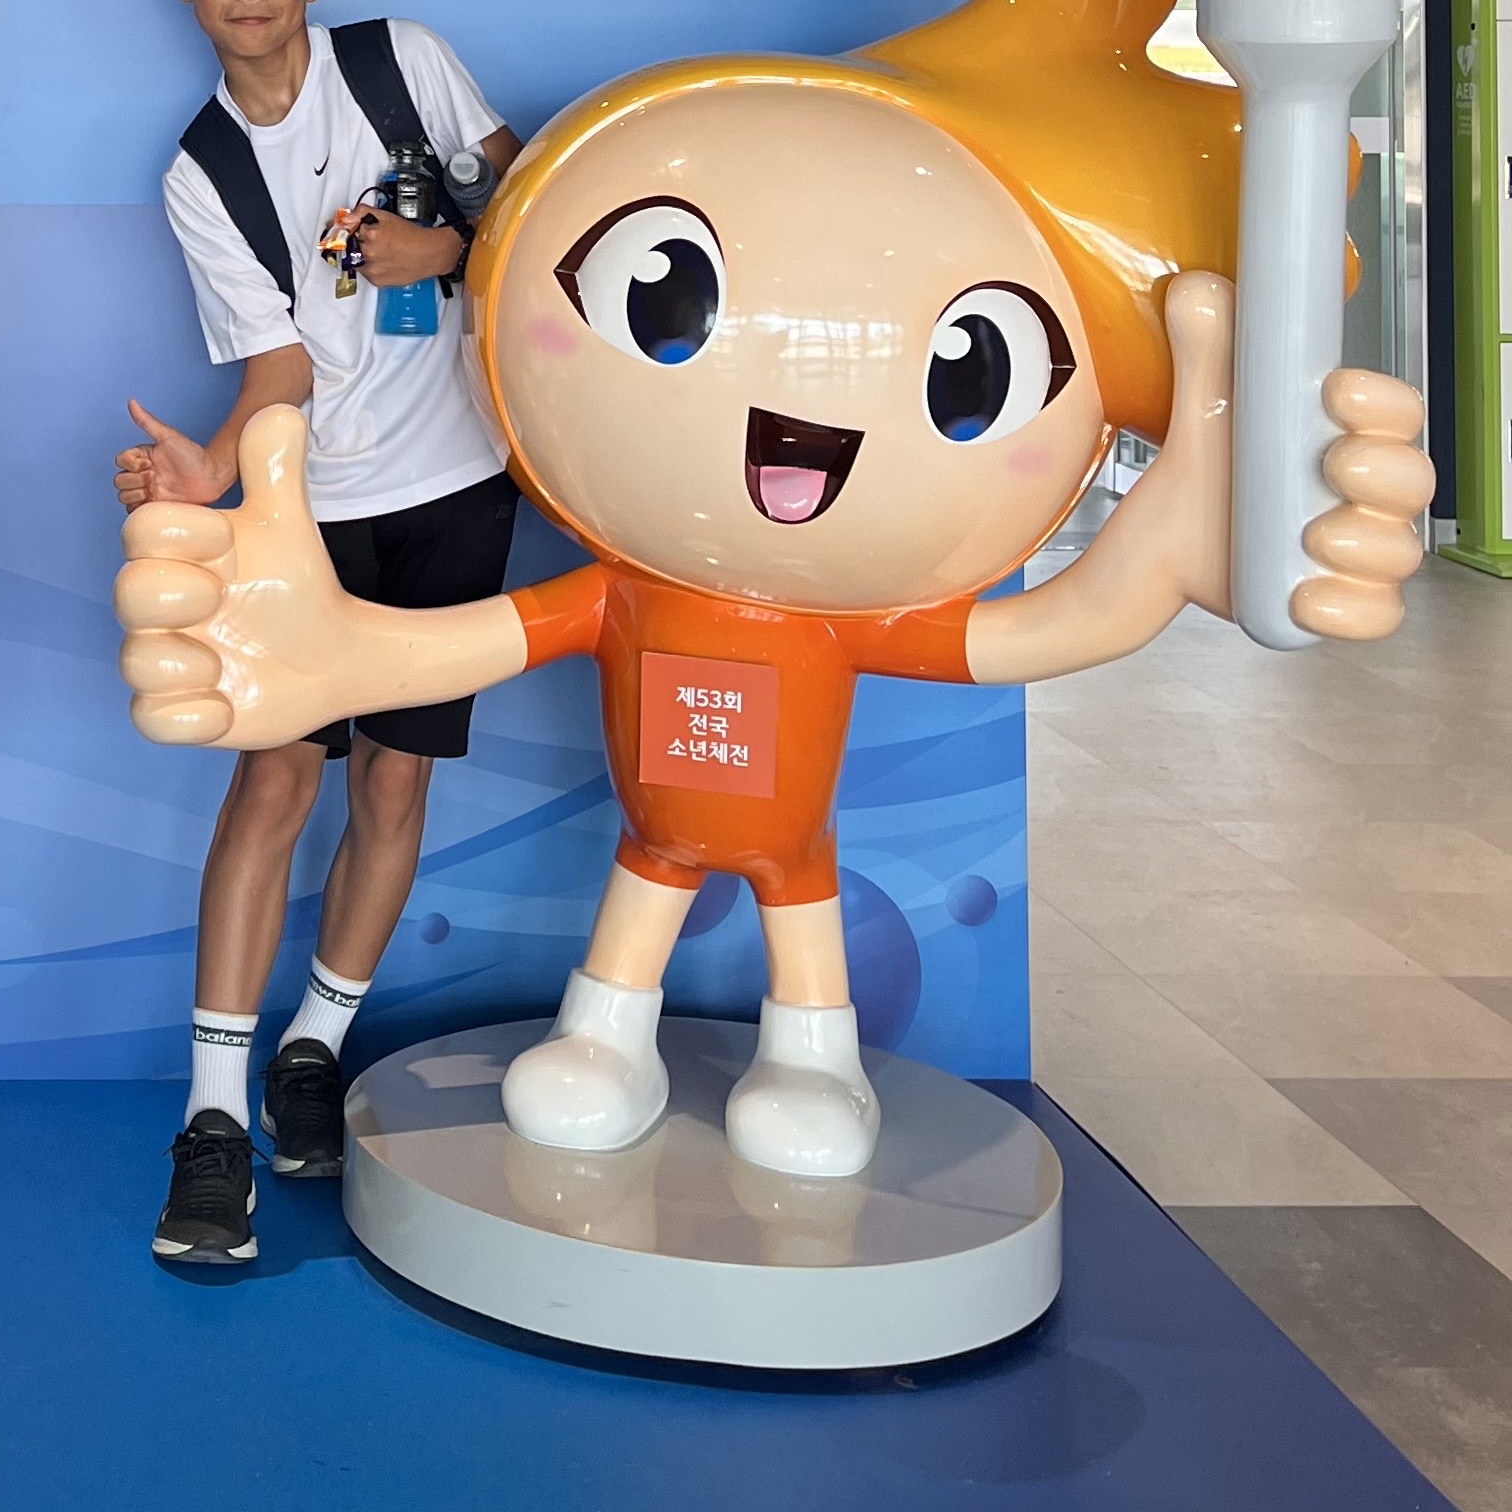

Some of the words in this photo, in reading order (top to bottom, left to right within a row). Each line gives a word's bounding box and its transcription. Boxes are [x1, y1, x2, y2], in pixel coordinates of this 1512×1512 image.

[675, 686, 742, 714] 제53회
[687, 713, 730, 739] 전국
[666, 737, 749, 768] 소년체전
